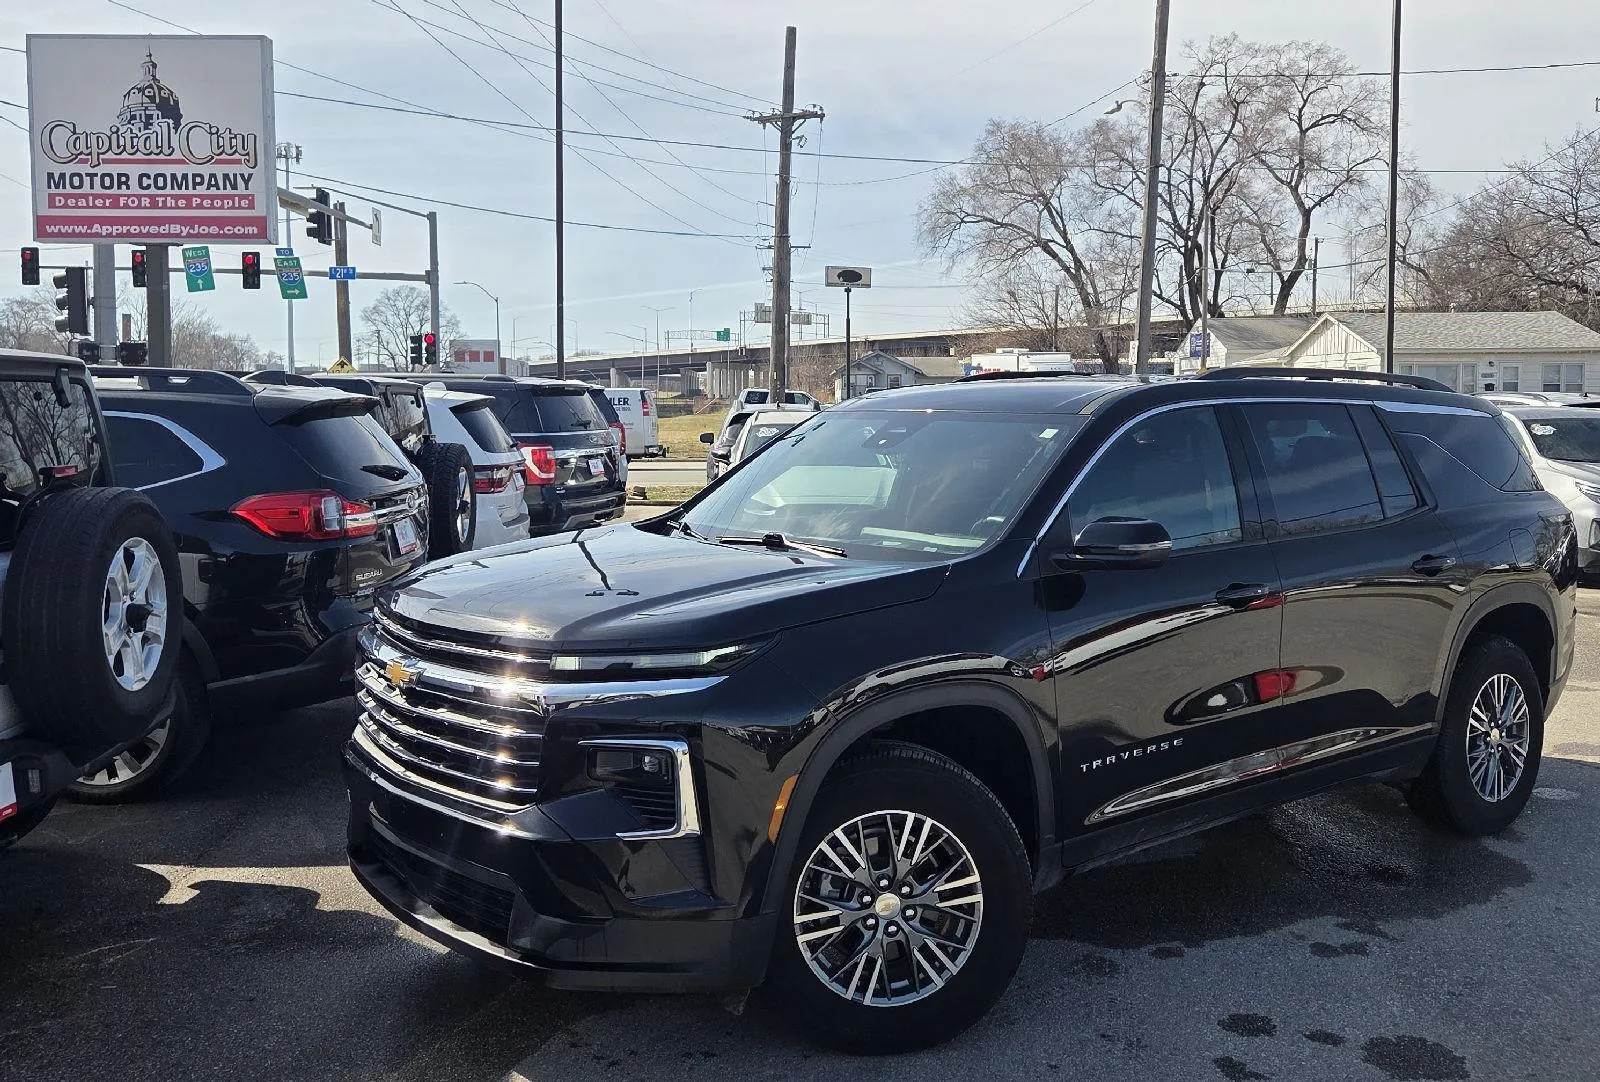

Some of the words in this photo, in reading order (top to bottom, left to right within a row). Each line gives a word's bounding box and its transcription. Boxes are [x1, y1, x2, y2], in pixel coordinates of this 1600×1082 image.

[41, 120, 175, 168] Capital
[179, 121, 257, 168] City
[46, 172, 131, 191] MOTOR
[137, 172, 254, 191] COMPANY
[55, 196, 112, 207] Dealer
[119, 197, 151, 207] FOR
[156, 197, 186, 207] The
[192, 197, 249, 209] People
[45, 223, 258, 236] www.ApprovedByJoe.com
[190, 262, 208, 272] 235
[281, 272, 300, 281] 235
[355, 568, 383, 581] SUBARU
[1080, 737, 1184, 773] TRAVERSE
